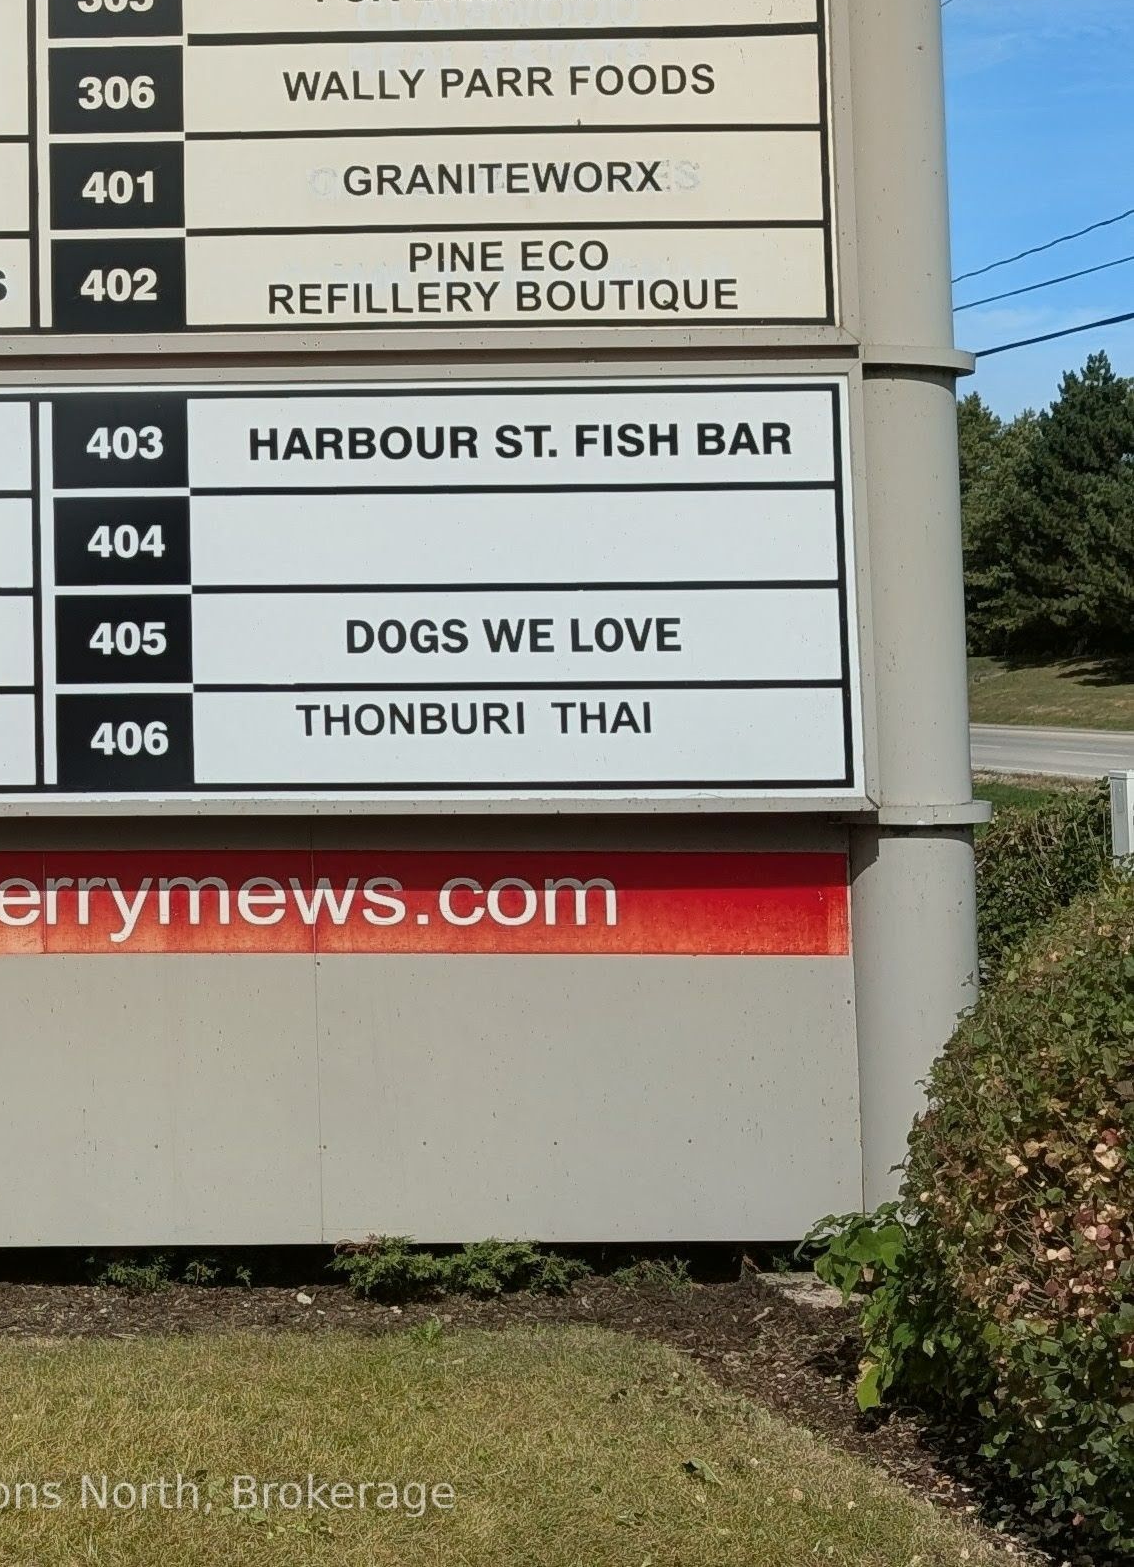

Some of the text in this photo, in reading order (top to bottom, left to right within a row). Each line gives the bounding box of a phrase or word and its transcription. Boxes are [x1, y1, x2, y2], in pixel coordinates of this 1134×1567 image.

[79, 76, 155, 109] 306
[283, 64, 714, 101] WALLY PARR FOODS
[82, 171, 153, 204] 401
[344, 162, 662, 196] GRANITEWORX
[410, 241, 608, 272] PINE ECO
[81, 268, 157, 301] 402
[269, 279, 738, 314] REFILLERY BOUTIQUE
[87, 426, 163, 459] 403
[250, 423, 791, 460] HARBOUR ST. FISH BAR
[88, 525, 165, 558] 404
[90, 622, 166, 655] 405
[347, 618, 681, 653] DOGS WE LOVE
[296, 702, 651, 736] THONBURI THAI
[91, 721, 168, 755] 406
